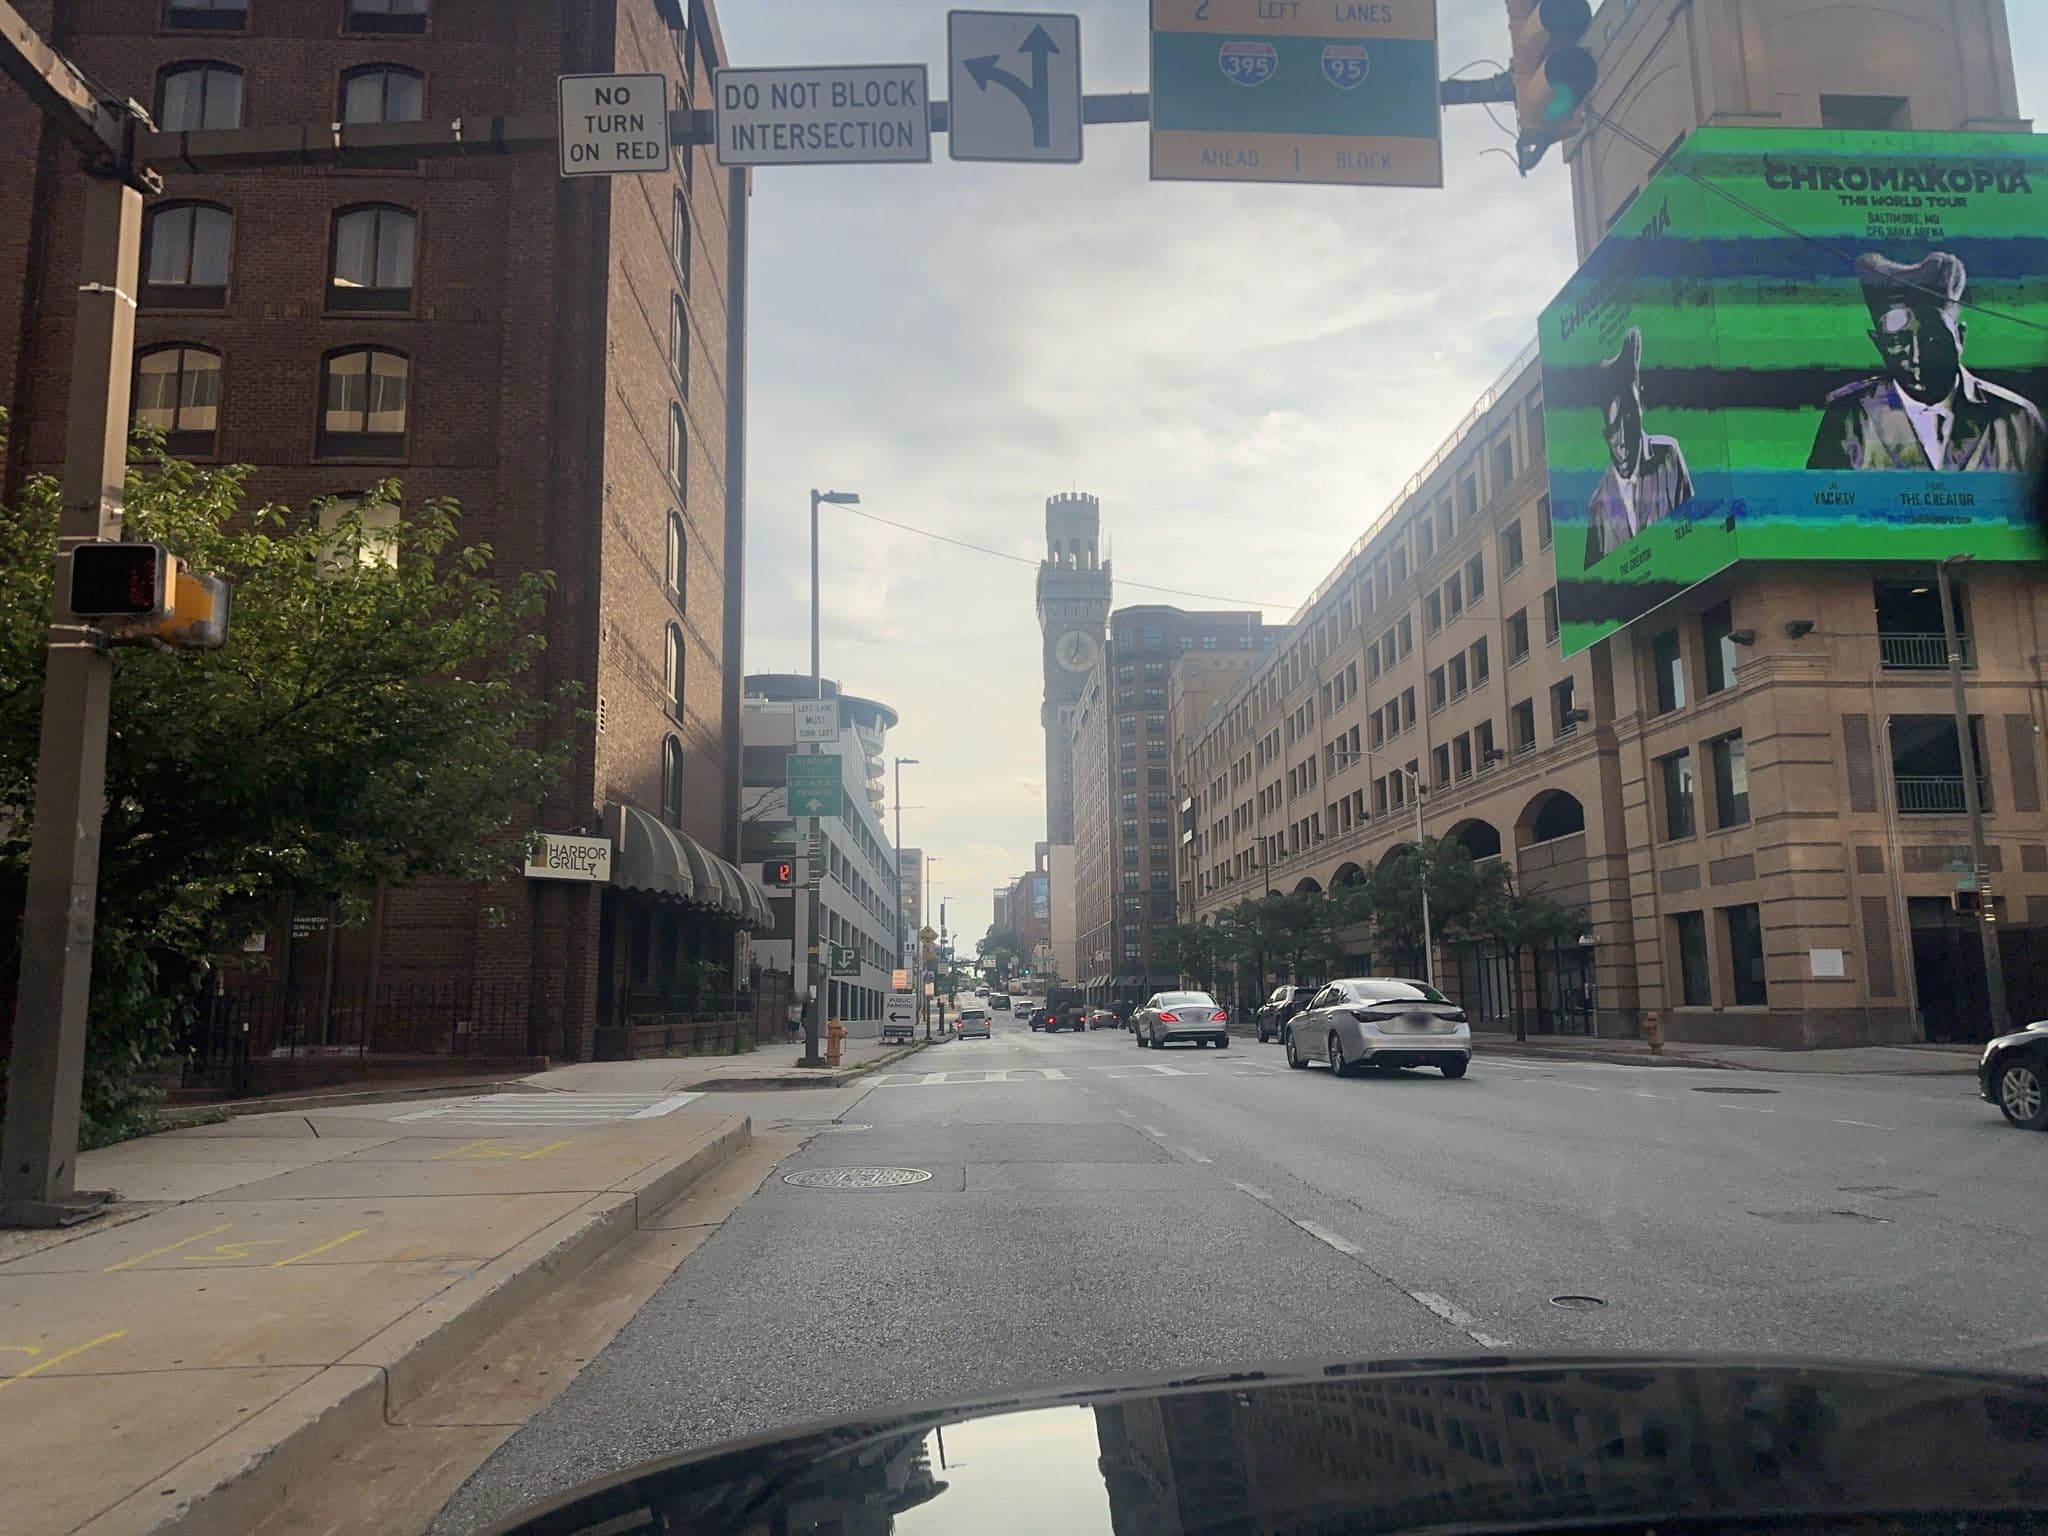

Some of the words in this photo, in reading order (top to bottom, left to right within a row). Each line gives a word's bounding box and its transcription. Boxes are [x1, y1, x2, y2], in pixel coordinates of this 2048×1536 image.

[1195, 0, 1209, 21] 2
[1258, 1, 1300, 20] LEFT
[1335, 4, 1393, 23] LANES
[1228, 56, 1270, 77] 395
[1331, 59, 1361, 79] 95
[594, 87, 631, 106] NO
[725, 84, 760, 110] DO
[771, 82, 821, 110] NOT
[832, 79, 917, 108] BLOCK
[584, 114, 645, 134] TURN
[731, 121, 915, 151] INTERSECTION
[570, 143, 600, 162] ON
[616, 141, 660, 161] RED
[1201, 148, 1259, 169] AHEAD
[1293, 147, 1300, 171] 1
[1336, 152, 1393, 171] BLOCK
[1762, 154, 2033, 194] CHROMAKOPIA
[1838, 195, 1868, 207] THE
[1872, 195, 1923, 208] WORLD
[1925, 196, 1969, 209] TOUR
[1900, 492, 1922, 506] THE
[1924, 493, 1976, 506] CREATOR
[798, 704, 813, 713] LEFT
[816, 704, 833, 712] LANE
[806, 715, 825, 724] MUST
[799, 729, 816, 737] TURN
[819, 729, 833, 737] LEFT
[549, 843, 607, 861] HARBOR
[549, 856, 588, 871] GRILL
